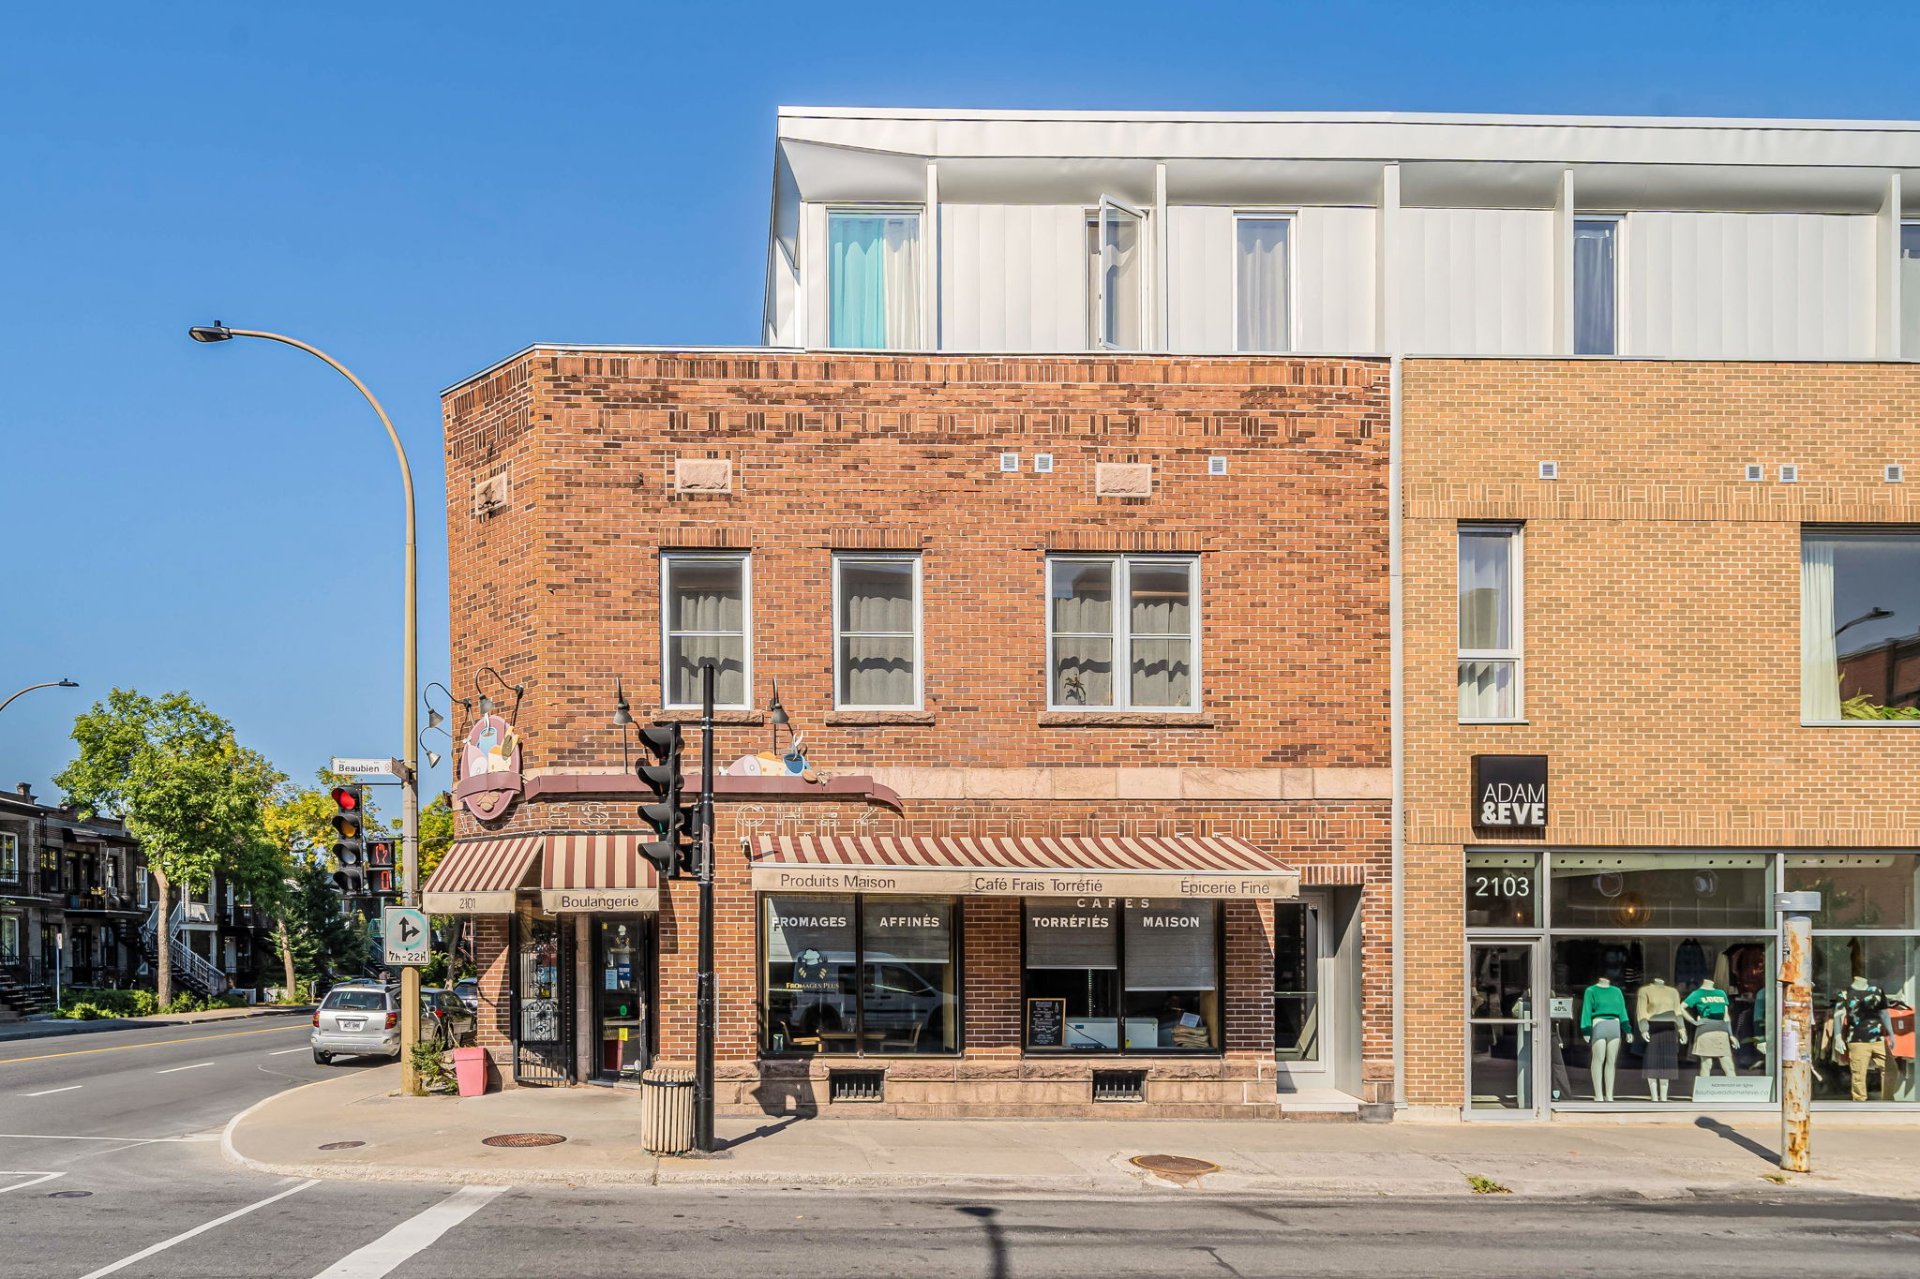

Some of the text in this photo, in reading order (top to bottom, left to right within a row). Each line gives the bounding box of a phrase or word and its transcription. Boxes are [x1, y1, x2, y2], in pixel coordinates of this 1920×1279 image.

[338, 764, 380, 773] Beaubien
[1482, 783, 1545, 802] ADAM
[1481, 801, 1546, 825] &EVE
[780, 873, 896, 889] Produits Maison
[975, 876, 1103, 893] Café Frais Torréfié
[1180, 876, 1270, 896] Épicerie Fine
[1475, 876, 1530, 897] 2103
[458, 897, 476, 910] 2101
[561, 895, 639, 911] Boulangerie
[772, 913, 940, 928] FROMAGES AFFINÉS
[1032, 914, 1200, 928] TORRÉFIÉS MAISON
